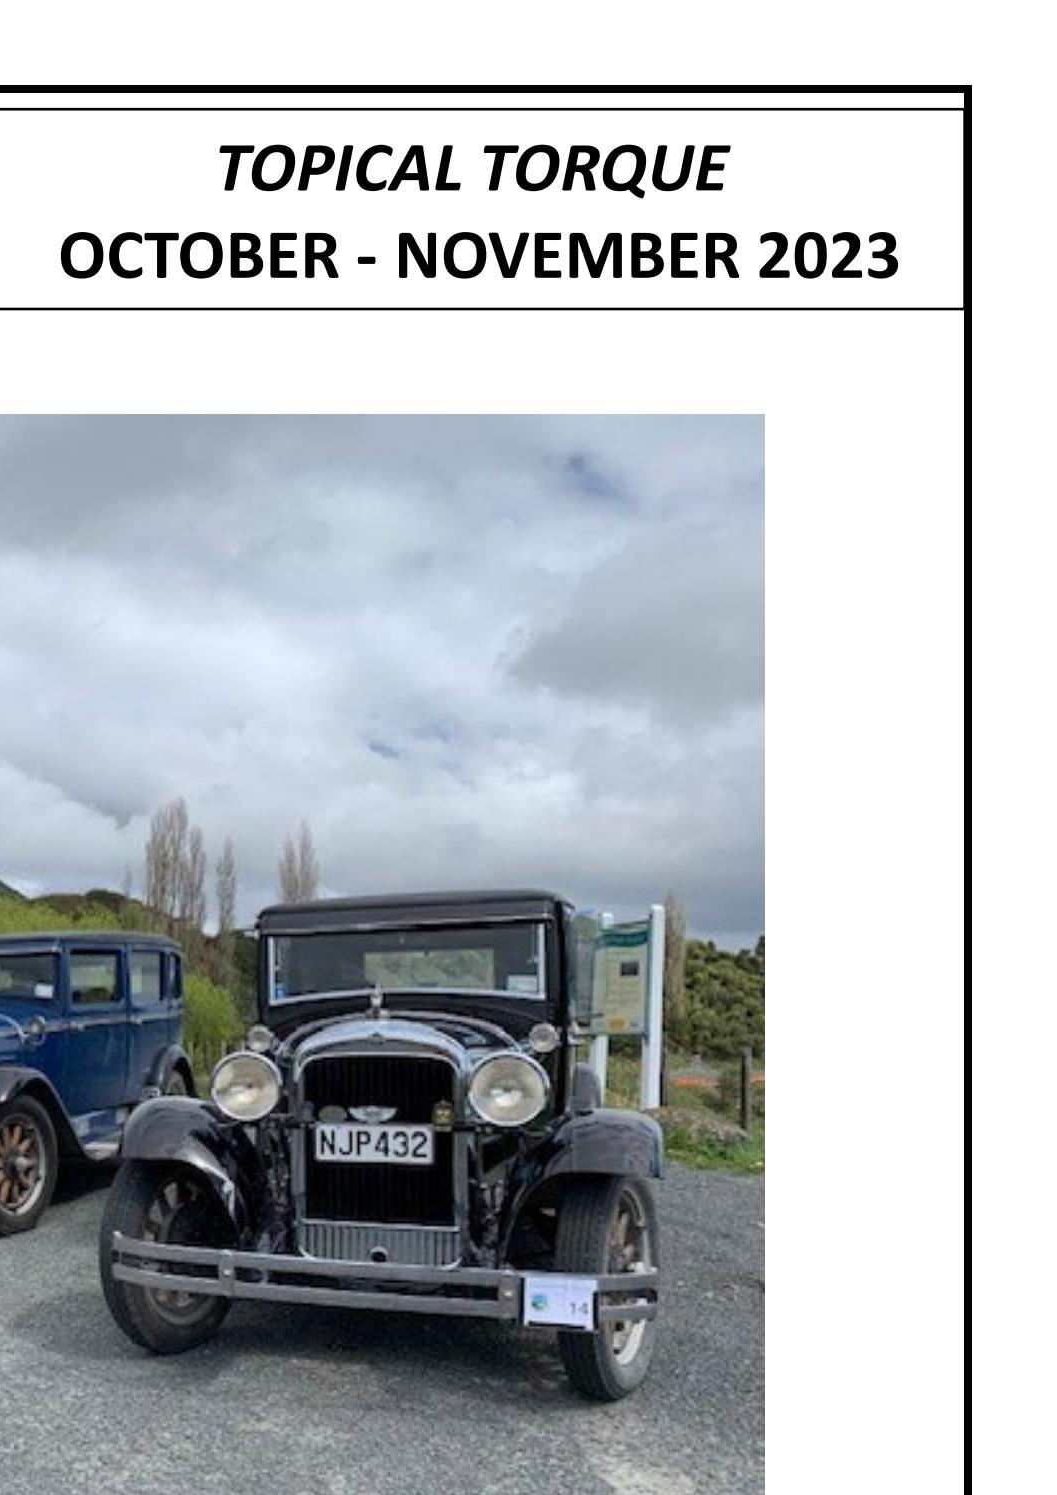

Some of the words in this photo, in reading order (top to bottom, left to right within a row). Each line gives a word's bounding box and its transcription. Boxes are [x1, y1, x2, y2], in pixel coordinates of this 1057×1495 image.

[220, 145, 461, 191] TOPICAL
[484, 145, 731, 198] TORQUE
[61, 232, 339, 279] OCTOBER
[399, 232, 739, 279] NOVEMBER
[760, 232, 898, 279] 2023
[320, 1130, 428, 1158] NJP432
